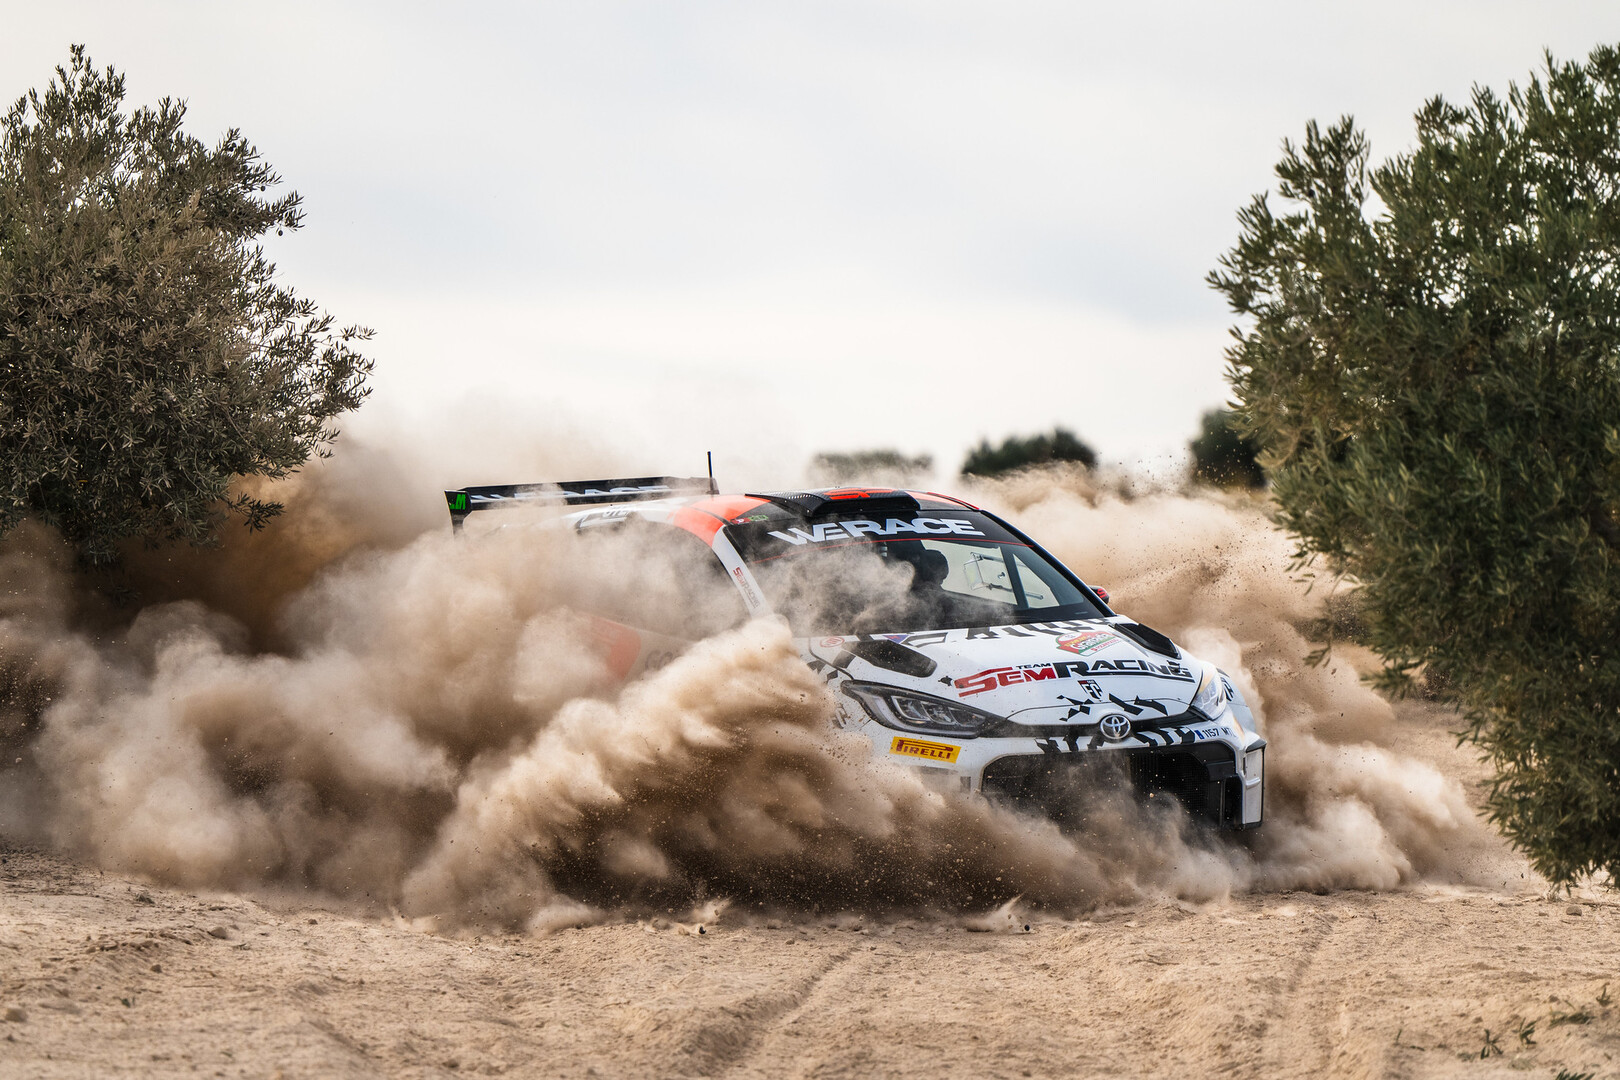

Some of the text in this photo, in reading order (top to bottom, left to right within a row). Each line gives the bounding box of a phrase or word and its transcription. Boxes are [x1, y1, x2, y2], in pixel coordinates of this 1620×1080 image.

[767, 518, 985, 546] WERACE
[1202, 728, 1219, 738] 1157
[896, 739, 954, 759] PIRELLI
